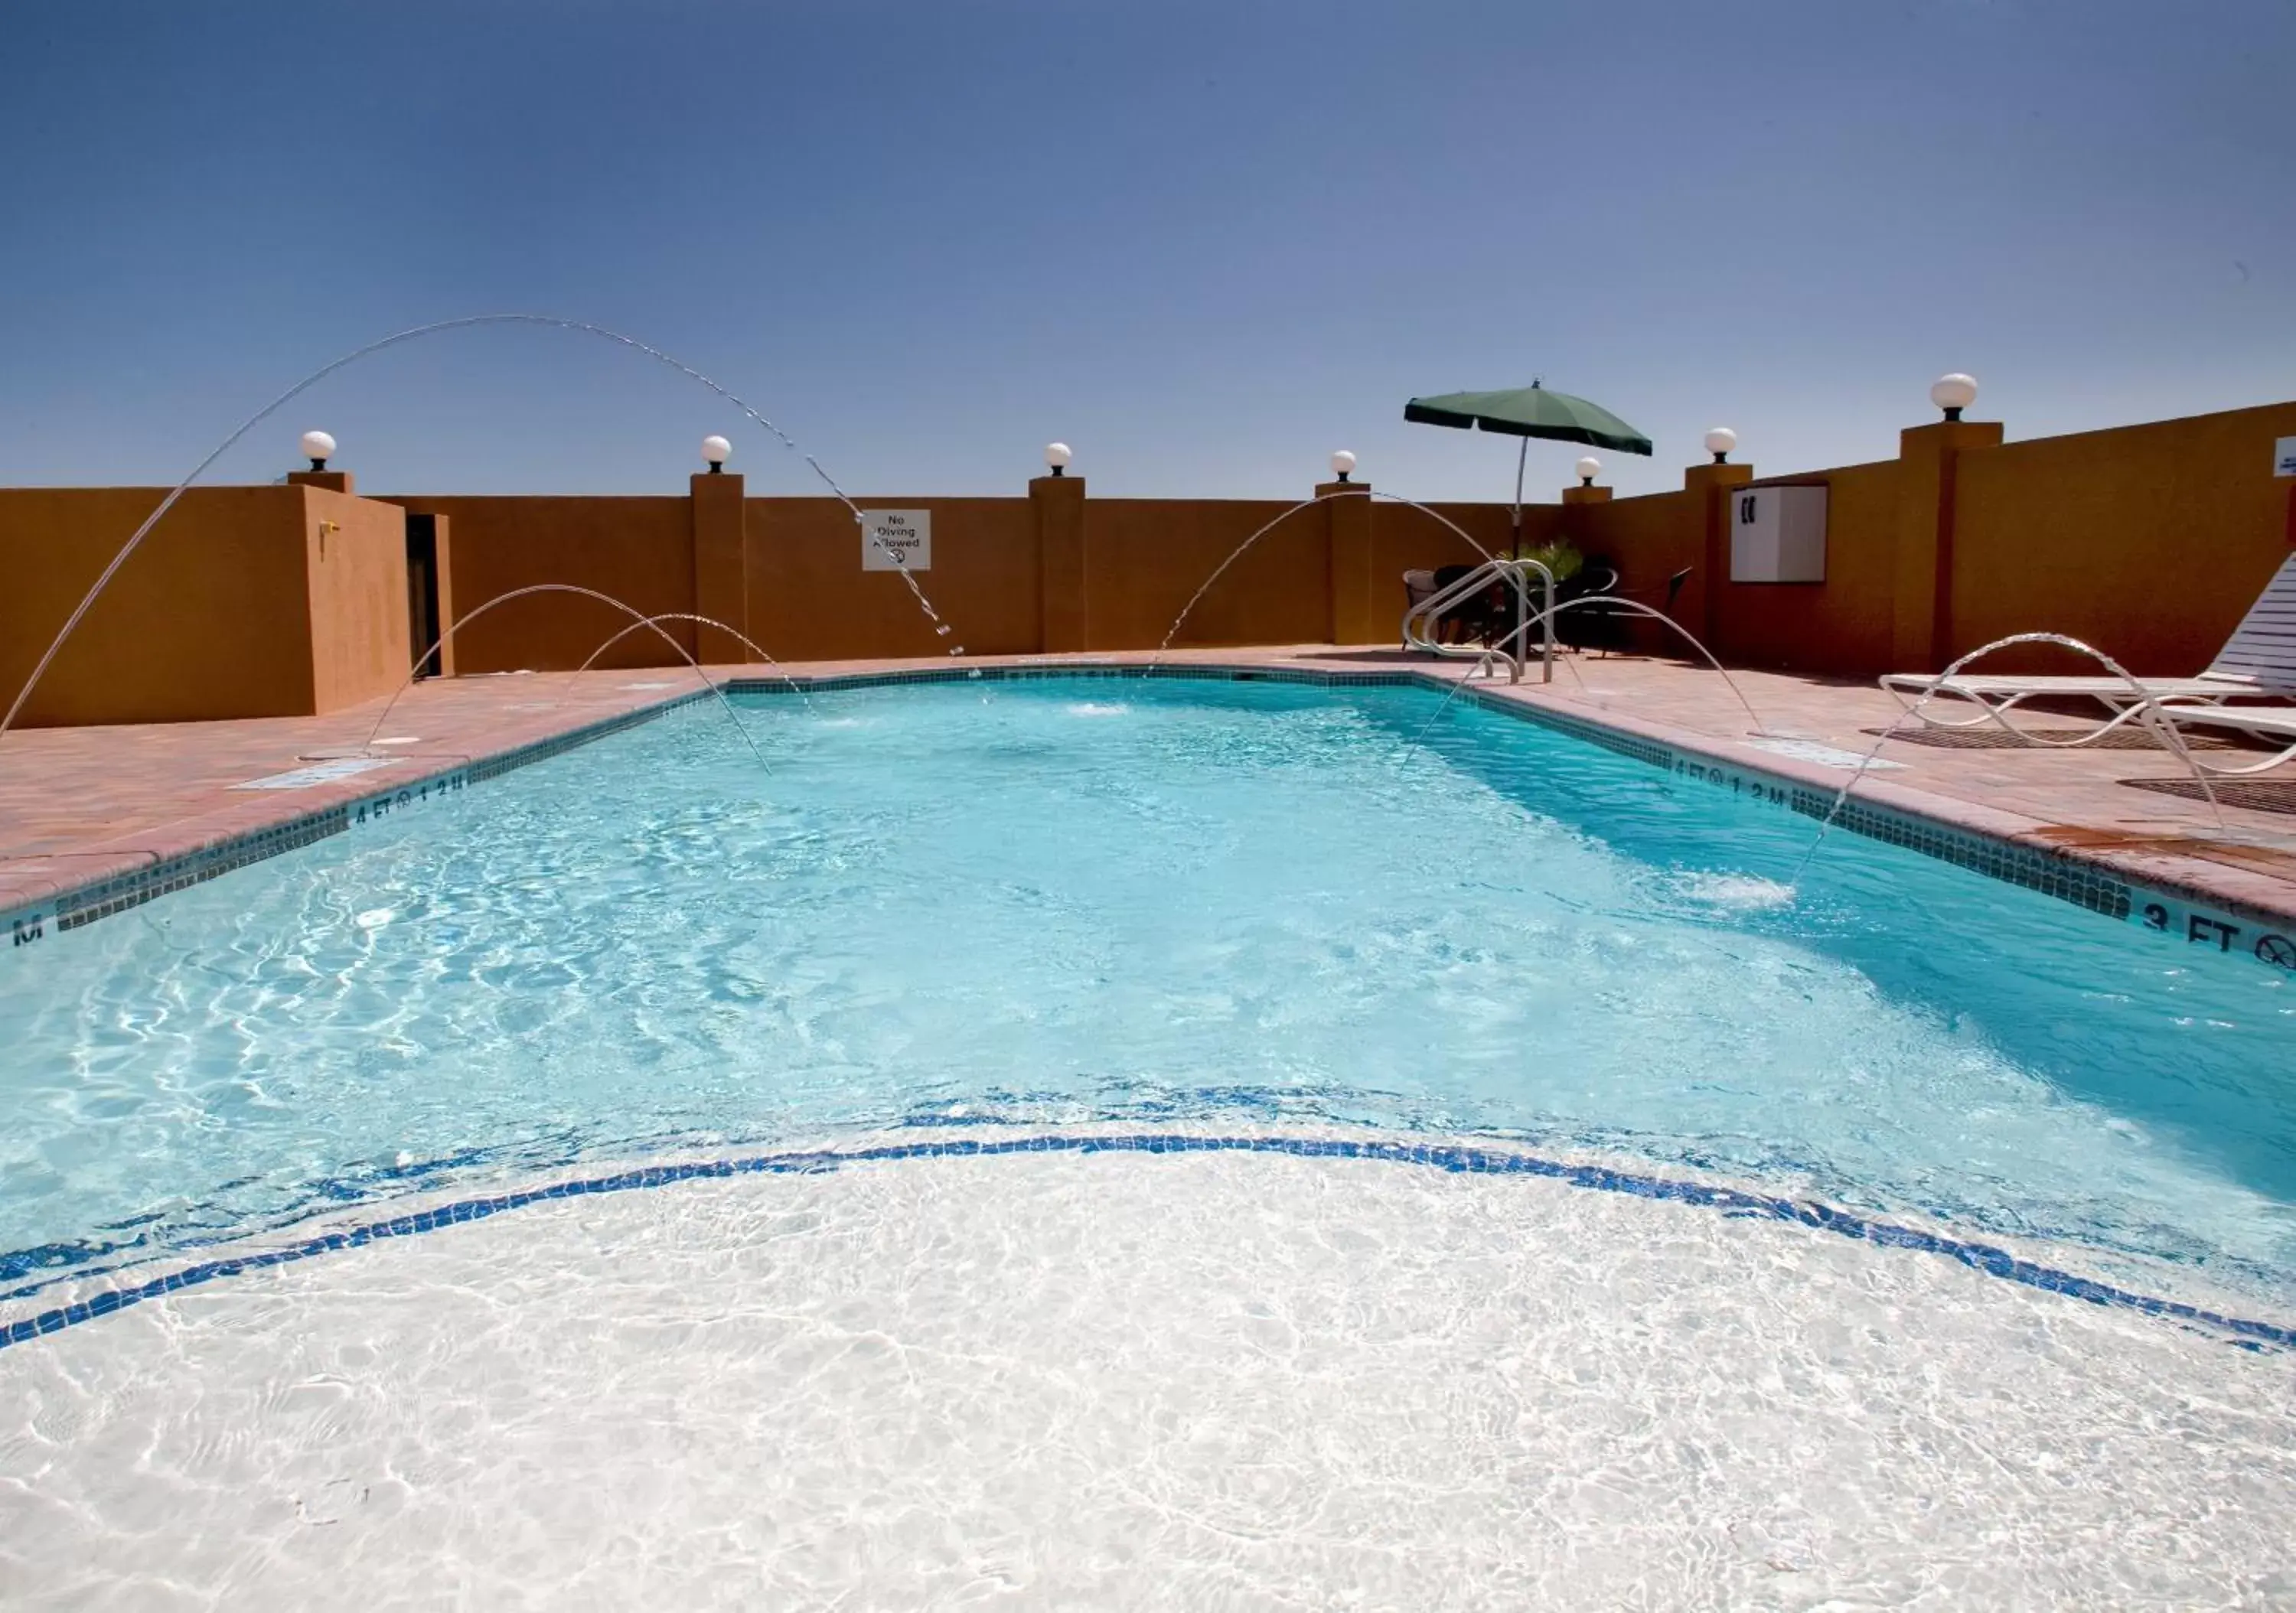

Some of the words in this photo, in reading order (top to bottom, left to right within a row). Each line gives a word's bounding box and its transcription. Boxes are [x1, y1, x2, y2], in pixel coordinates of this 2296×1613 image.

[889, 515, 905, 525] No
[877, 526, 916, 537] Diving
[1689, 762, 1706, 780] FT
[373, 797, 392, 819] FT
[12, 914, 42, 946] M
[2189, 914, 2241, 953] FT
